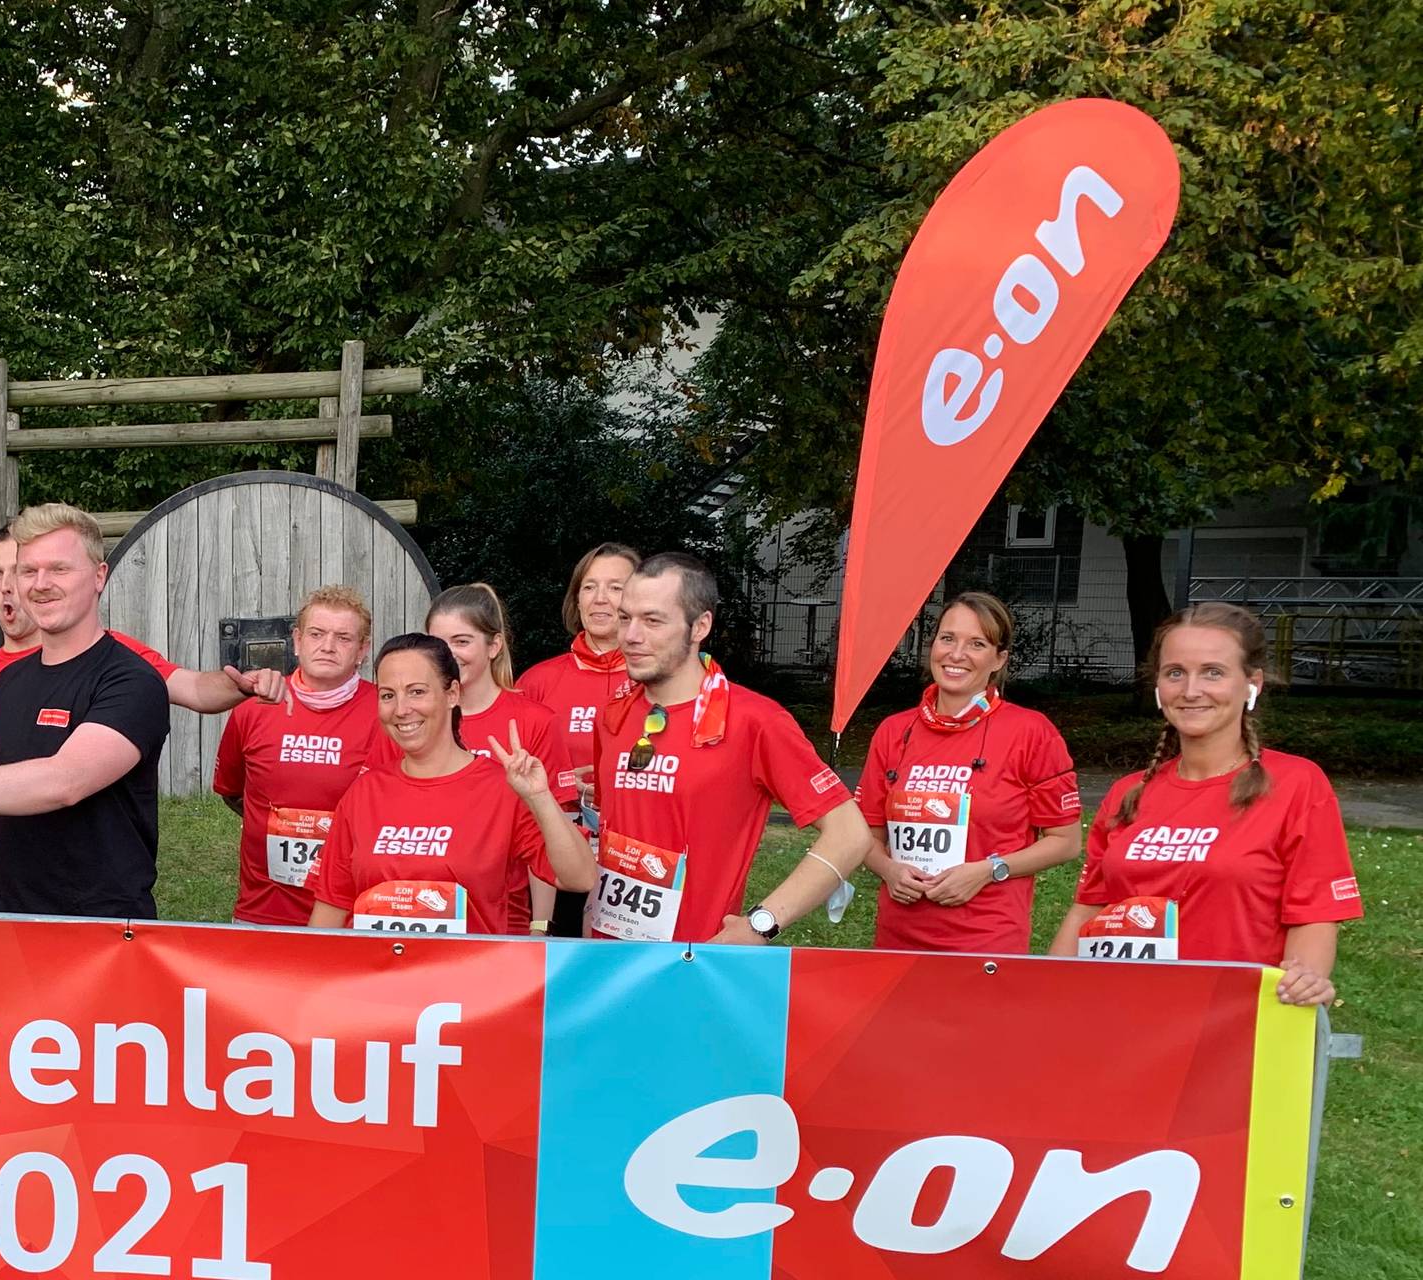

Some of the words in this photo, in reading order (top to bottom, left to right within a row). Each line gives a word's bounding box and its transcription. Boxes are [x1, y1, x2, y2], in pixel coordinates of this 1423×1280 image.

[281, 734, 343, 750] RADIO
[279, 749, 341, 765] ESSEN
[616, 752, 680, 774] RDIO
[908, 765, 973, 782] RADIO
[614, 772, 676, 794] ESSEN
[904, 780, 968, 794] ESSEN
[377, 826, 453, 842] RADIO
[893, 825, 952, 854] 1340
[1133, 826, 1220, 845] RADIO
[372, 841, 449, 857] ESSEN
[1124, 843, 1211, 862] ESSEN
[597, 873, 664, 918] 1345
